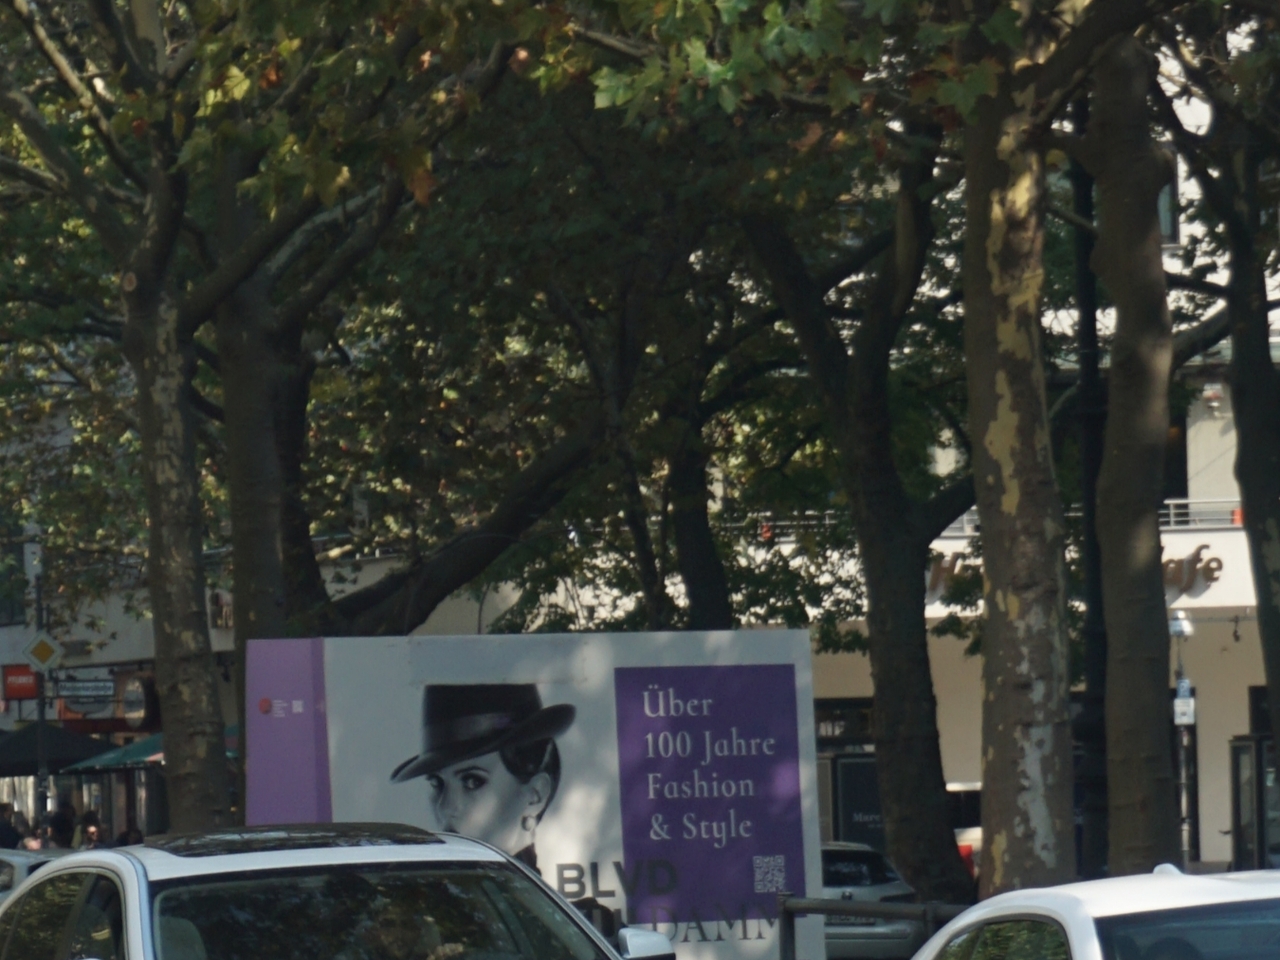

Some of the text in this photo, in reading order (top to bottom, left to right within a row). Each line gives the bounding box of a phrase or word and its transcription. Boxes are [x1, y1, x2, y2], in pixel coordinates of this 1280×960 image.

[1162, 545, 1224, 593] afe
[643, 684, 713, 718] Über
[645, 727, 776, 766] 100 Jahre
[647, 769, 755, 800] Fashion
[650, 808, 753, 848] & Style
[556, 858, 678, 900] BLVD
